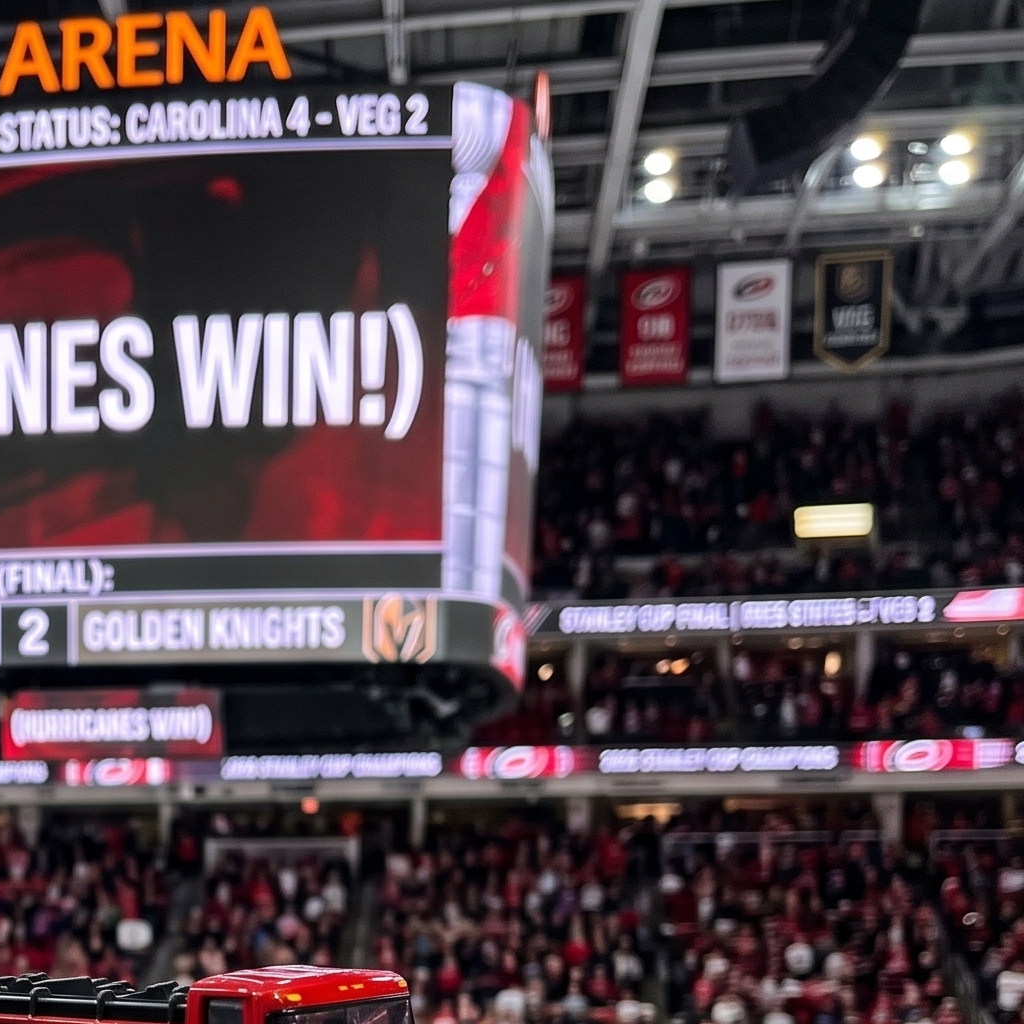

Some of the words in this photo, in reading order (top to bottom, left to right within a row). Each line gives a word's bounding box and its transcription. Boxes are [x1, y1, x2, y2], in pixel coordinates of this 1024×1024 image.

[125, 96, 283, 145] CAROLINA
[285, 95, 311, 137] 4
[335, 93, 401, 136] VEG
[404, 93, 429, 135] 2
[172, 303, 423, 440] WIN!)
[18, 608, 50, 656] 2
[82, 608, 205, 652] GOLDEN
[208, 605, 346, 649] KNIGHTS
